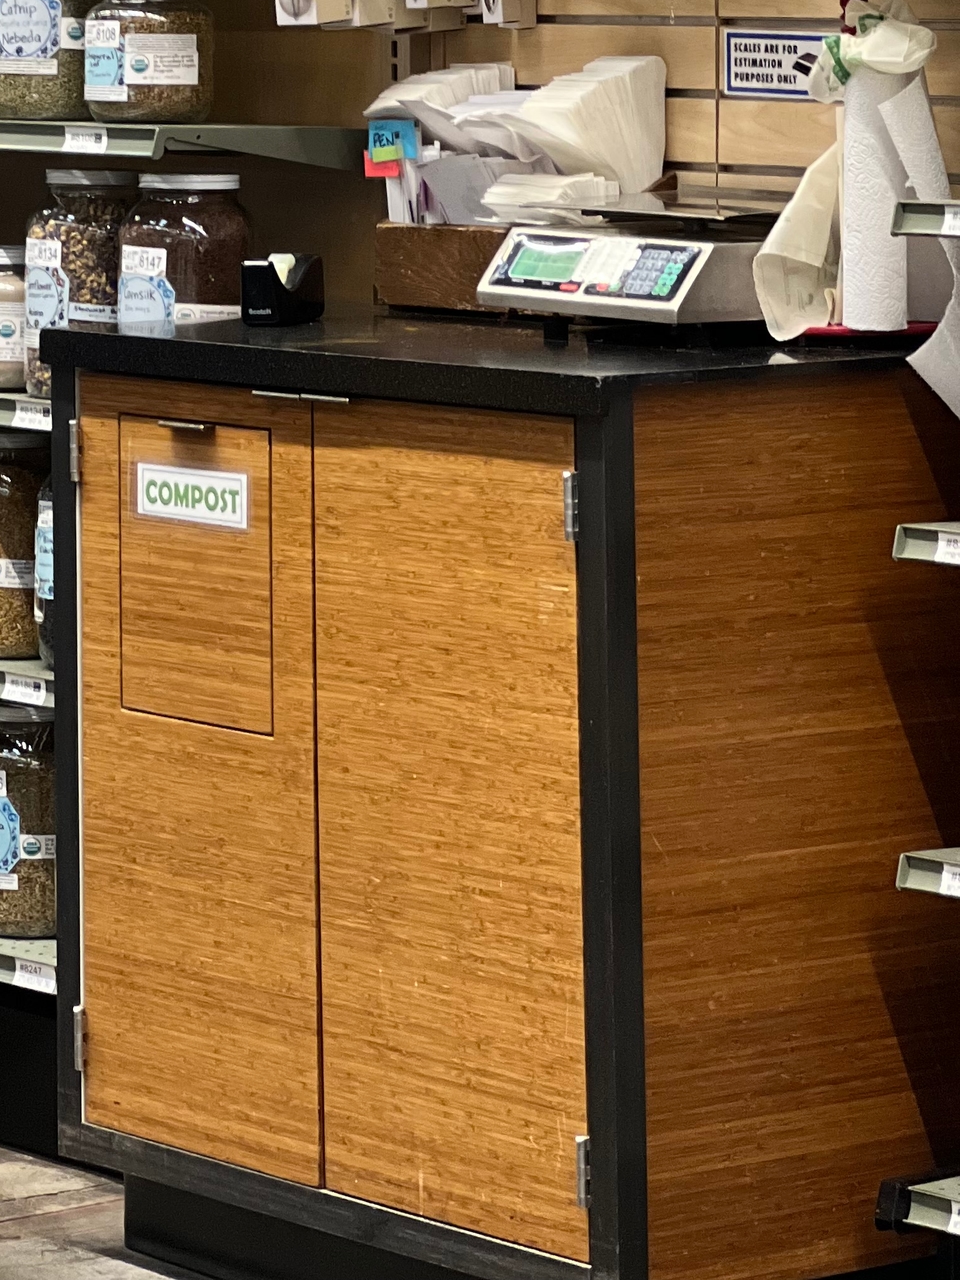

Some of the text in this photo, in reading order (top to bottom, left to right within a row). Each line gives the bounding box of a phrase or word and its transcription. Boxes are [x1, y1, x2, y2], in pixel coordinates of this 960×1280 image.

[0, 2, 37, 17] Catnip
[96, 29, 116, 42] 8108
[734, 42, 798, 56] SCALES ARE FOR
[734, 57, 783, 69] ESTIMATION
[734, 71, 798, 85] PURPOSES ONLY
[372, 133, 395, 149] PEN
[38, 248, 58, 259] 8134
[140, 256, 162, 268] 8147
[124, 289, 156, 301] Cornsilk
[249, 307, 272, 316] Scotch
[145, 479, 240, 514] COMPOST
[19, 963, 42, 975] #8247
